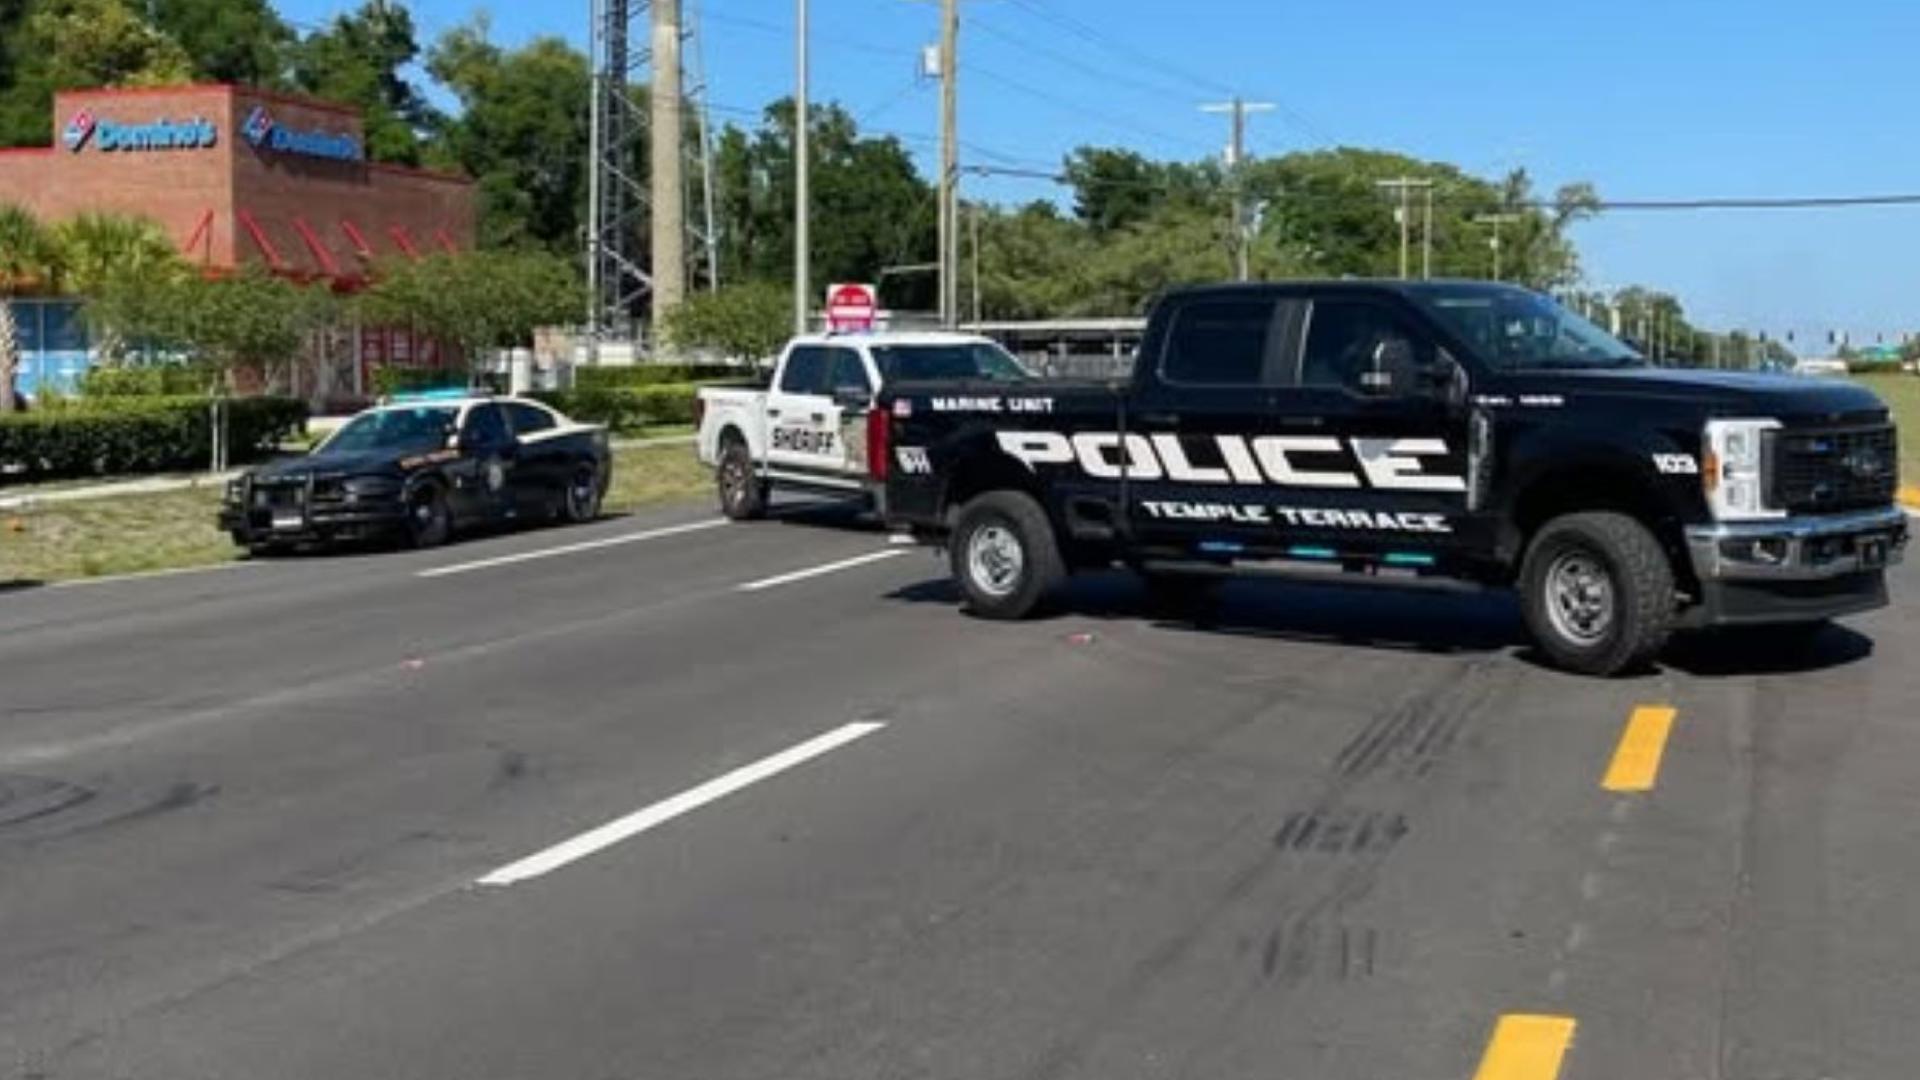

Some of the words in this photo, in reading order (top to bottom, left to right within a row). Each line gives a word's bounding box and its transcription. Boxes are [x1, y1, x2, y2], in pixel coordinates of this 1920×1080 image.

[97, 118, 215, 150] Domino's
[931, 397, 1004, 412] MARINE
[1008, 397, 1054, 413] UNIT
[773, 427, 834, 453] SHERIFF
[996, 431, 1467, 492] POLICE
[1142, 500, 1273, 522] TEMPLE
[1279, 506, 1454, 533] TERRACE
